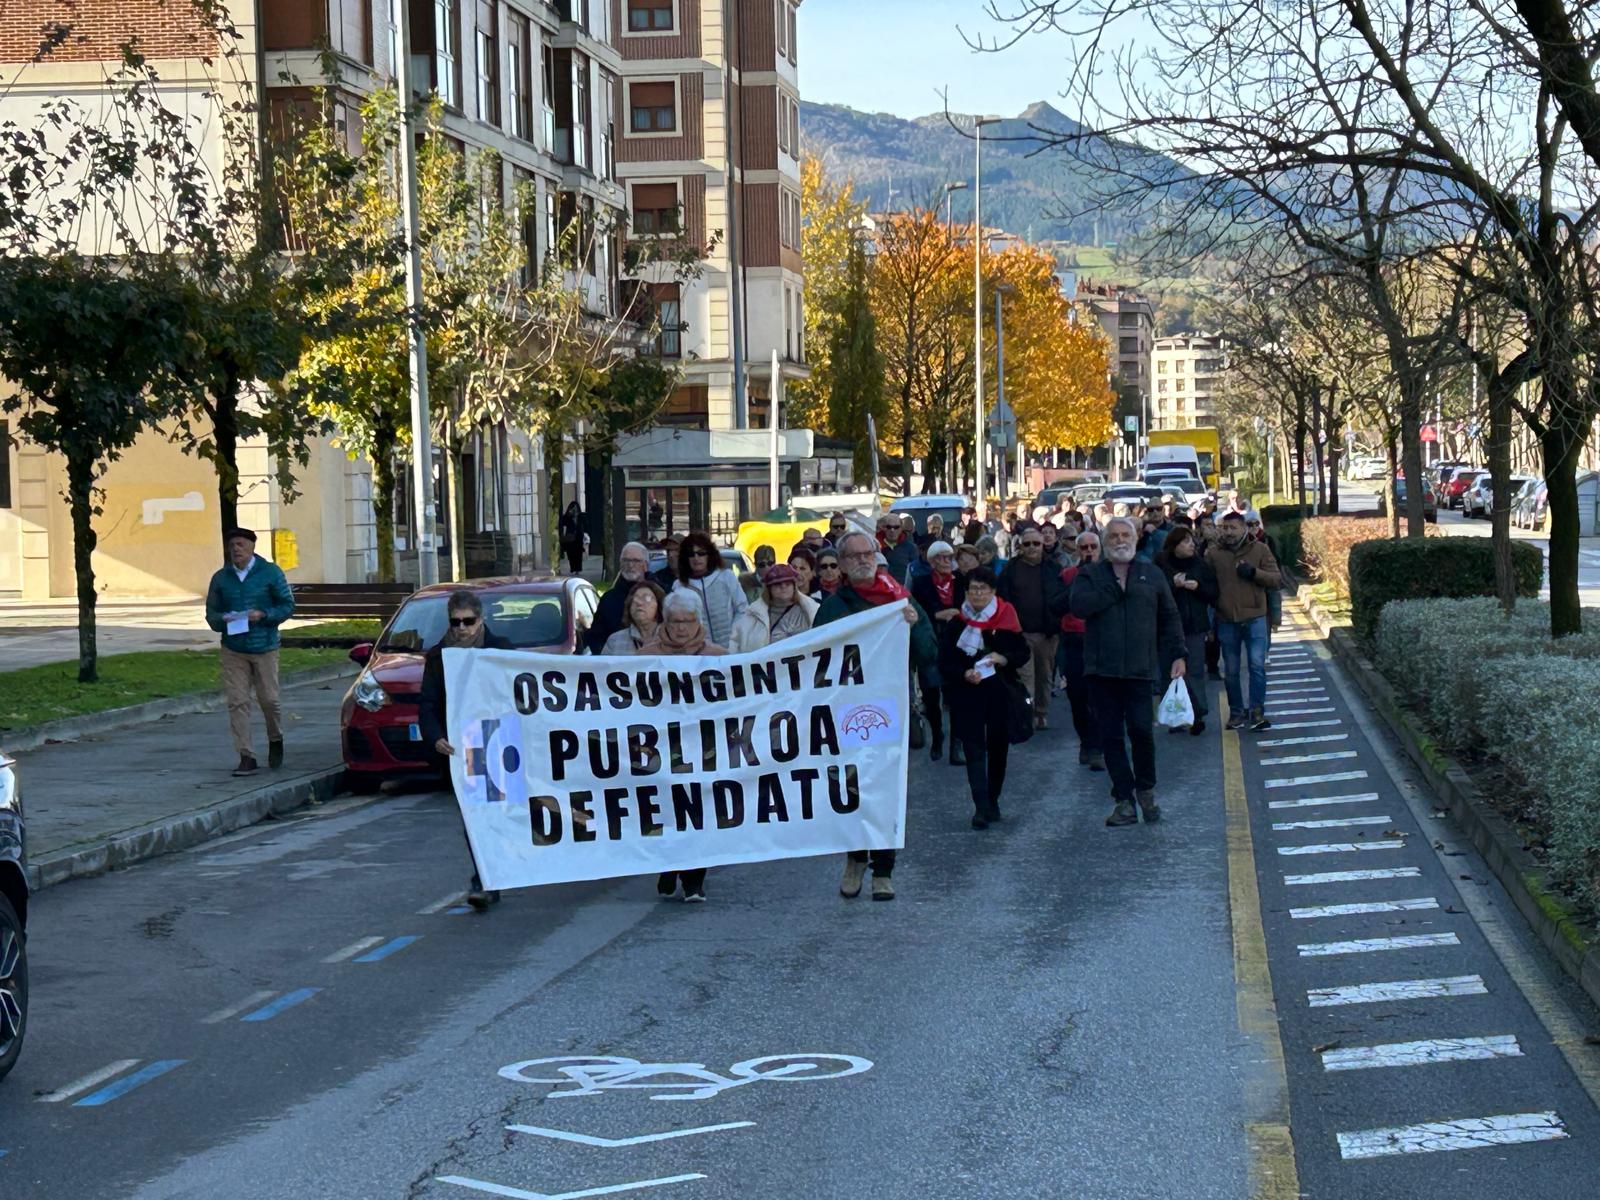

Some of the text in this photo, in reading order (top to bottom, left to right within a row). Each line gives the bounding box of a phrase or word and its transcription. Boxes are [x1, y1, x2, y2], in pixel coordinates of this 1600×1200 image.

[513, 643, 865, 716] OSASUNGINTZA
[548, 704, 841, 782] PUBLIKOA
[528, 763, 861, 847] DEFENDATU
